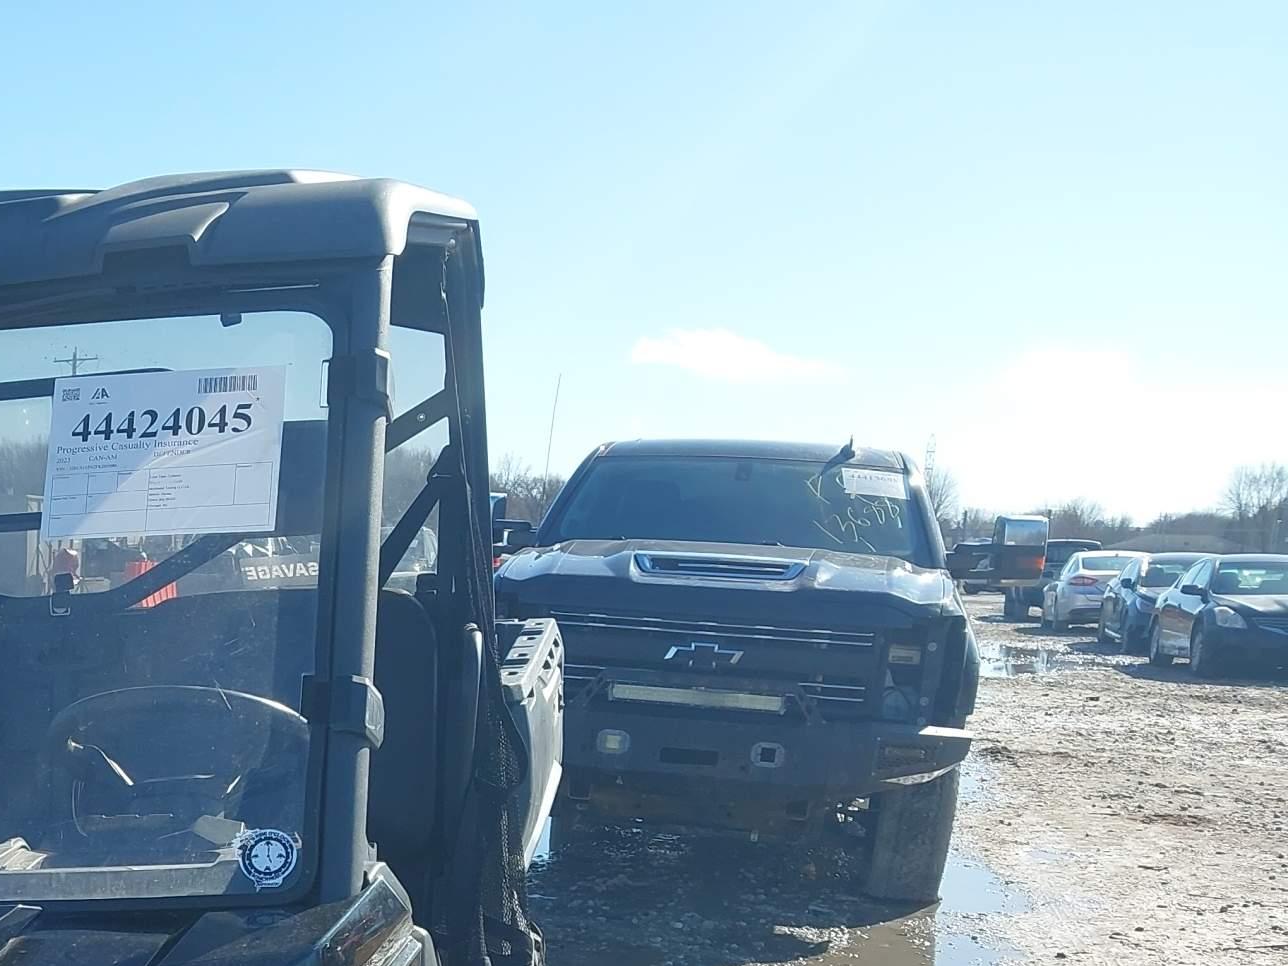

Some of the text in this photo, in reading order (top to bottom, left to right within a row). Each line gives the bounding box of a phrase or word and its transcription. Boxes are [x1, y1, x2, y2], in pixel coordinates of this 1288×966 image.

[71, 403, 253, 443] 44424045
[56, 438, 199, 456] Progressive Casualty Insurance
